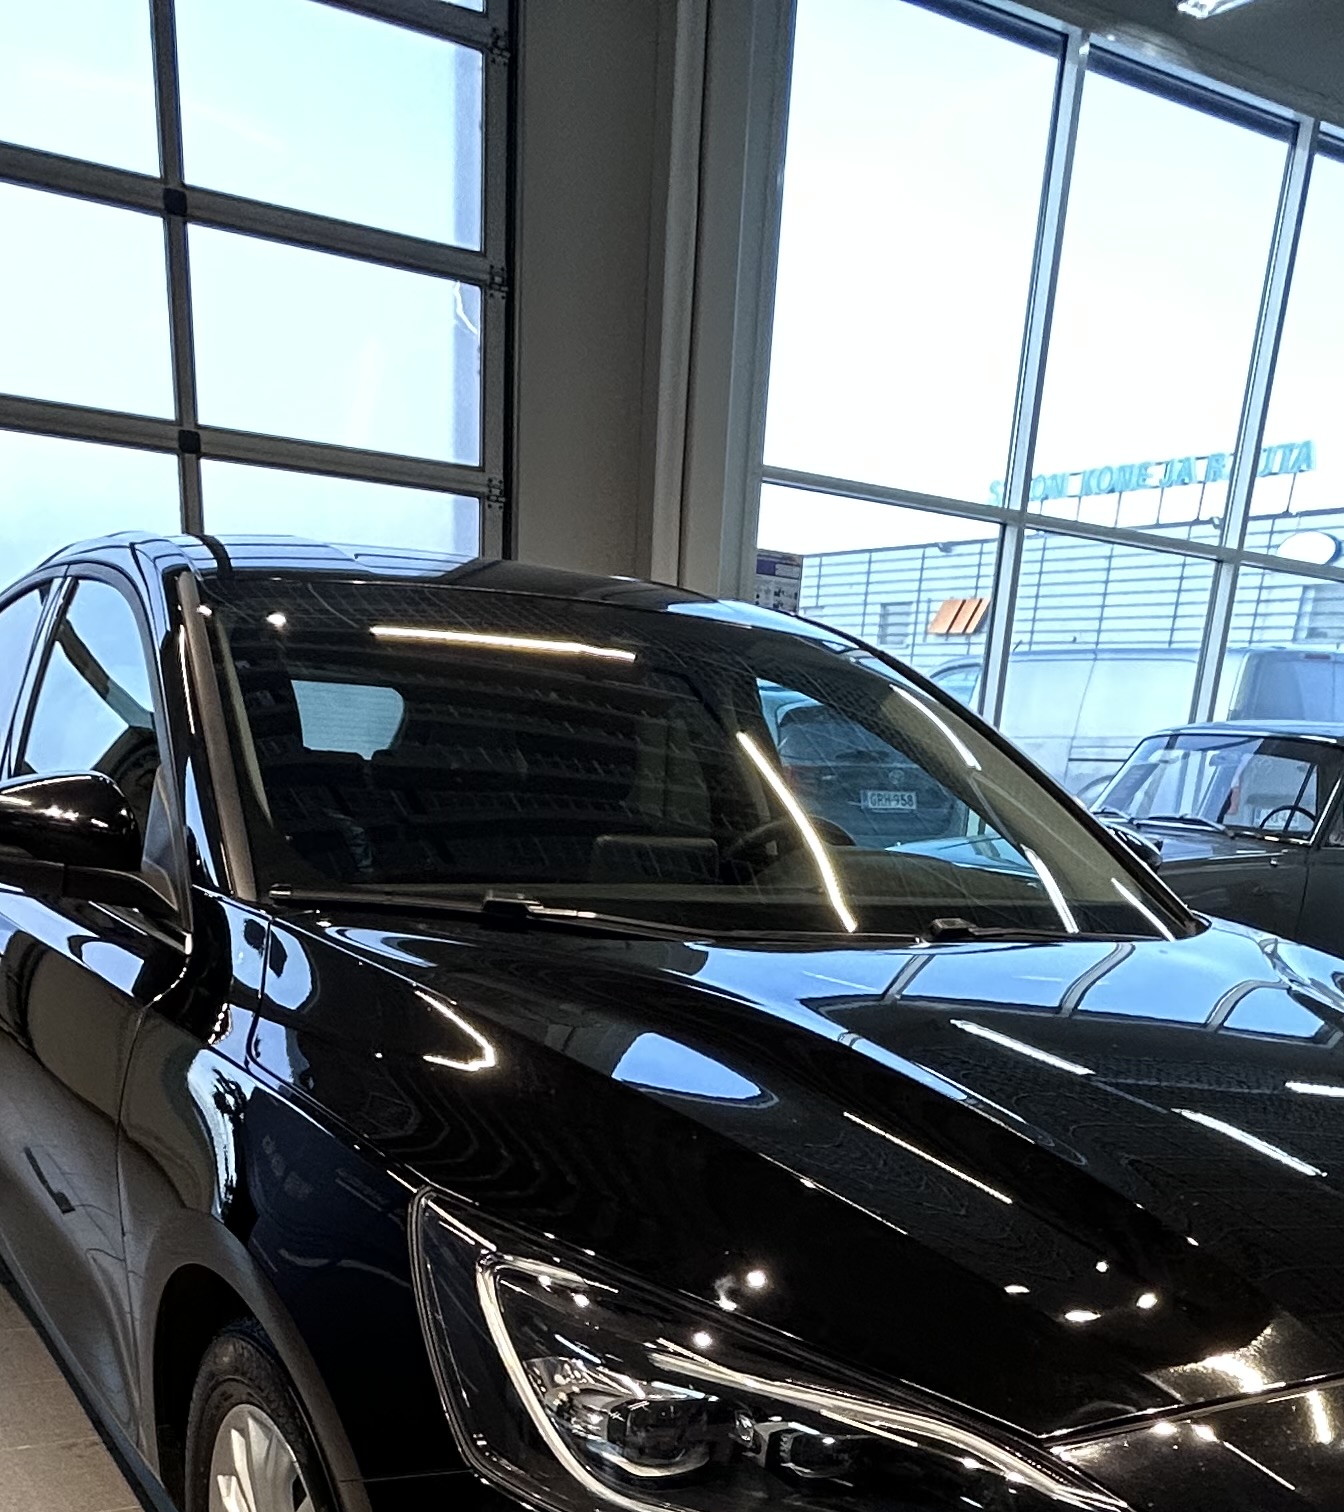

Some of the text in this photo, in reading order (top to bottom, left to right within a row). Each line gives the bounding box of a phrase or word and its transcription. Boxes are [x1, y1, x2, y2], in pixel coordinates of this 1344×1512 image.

[988, 473, 1067, 506] SON
[1080, 461, 1153, 497] KONE
[1158, 457, 1196, 487] JA
